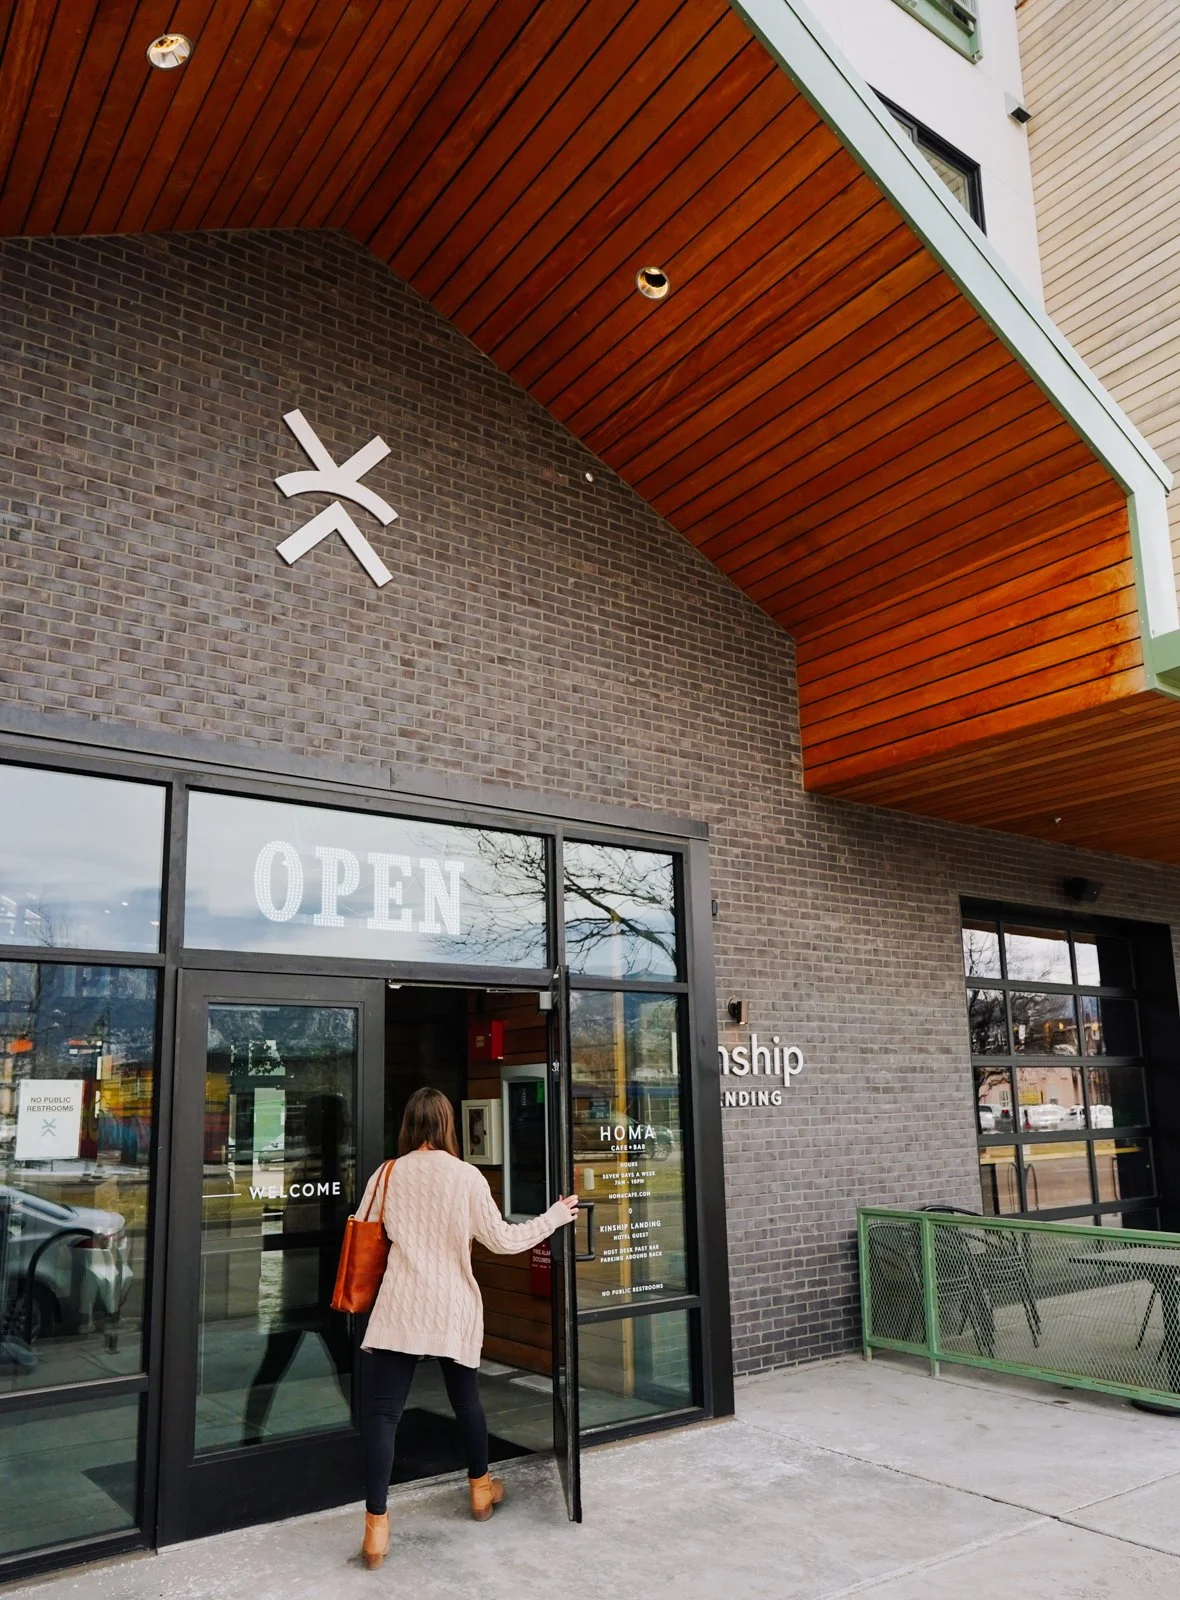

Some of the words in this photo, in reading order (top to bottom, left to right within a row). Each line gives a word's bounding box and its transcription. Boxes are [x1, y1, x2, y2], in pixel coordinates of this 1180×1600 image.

[254, 840, 465, 935] OPEN
[720, 1090, 782, 1107] NDING
[600, 1124, 655, 1141] HOMA
[249, 1181, 341, 1200] WELCOME
[608, 1191, 651, 1199] HOMACAFE.COM
[600, 1224, 628, 1232] KINSHIP
[630, 1220, 661, 1230] LANDING
[631, 1231, 649, 1239] GUEST
[625, 1252, 648, 1260] AROUND
[648, 1250, 663, 1258] BACK
[611, 1287, 632, 1296] PUBLIC
[632, 1283, 664, 1293] RESTROOMS
